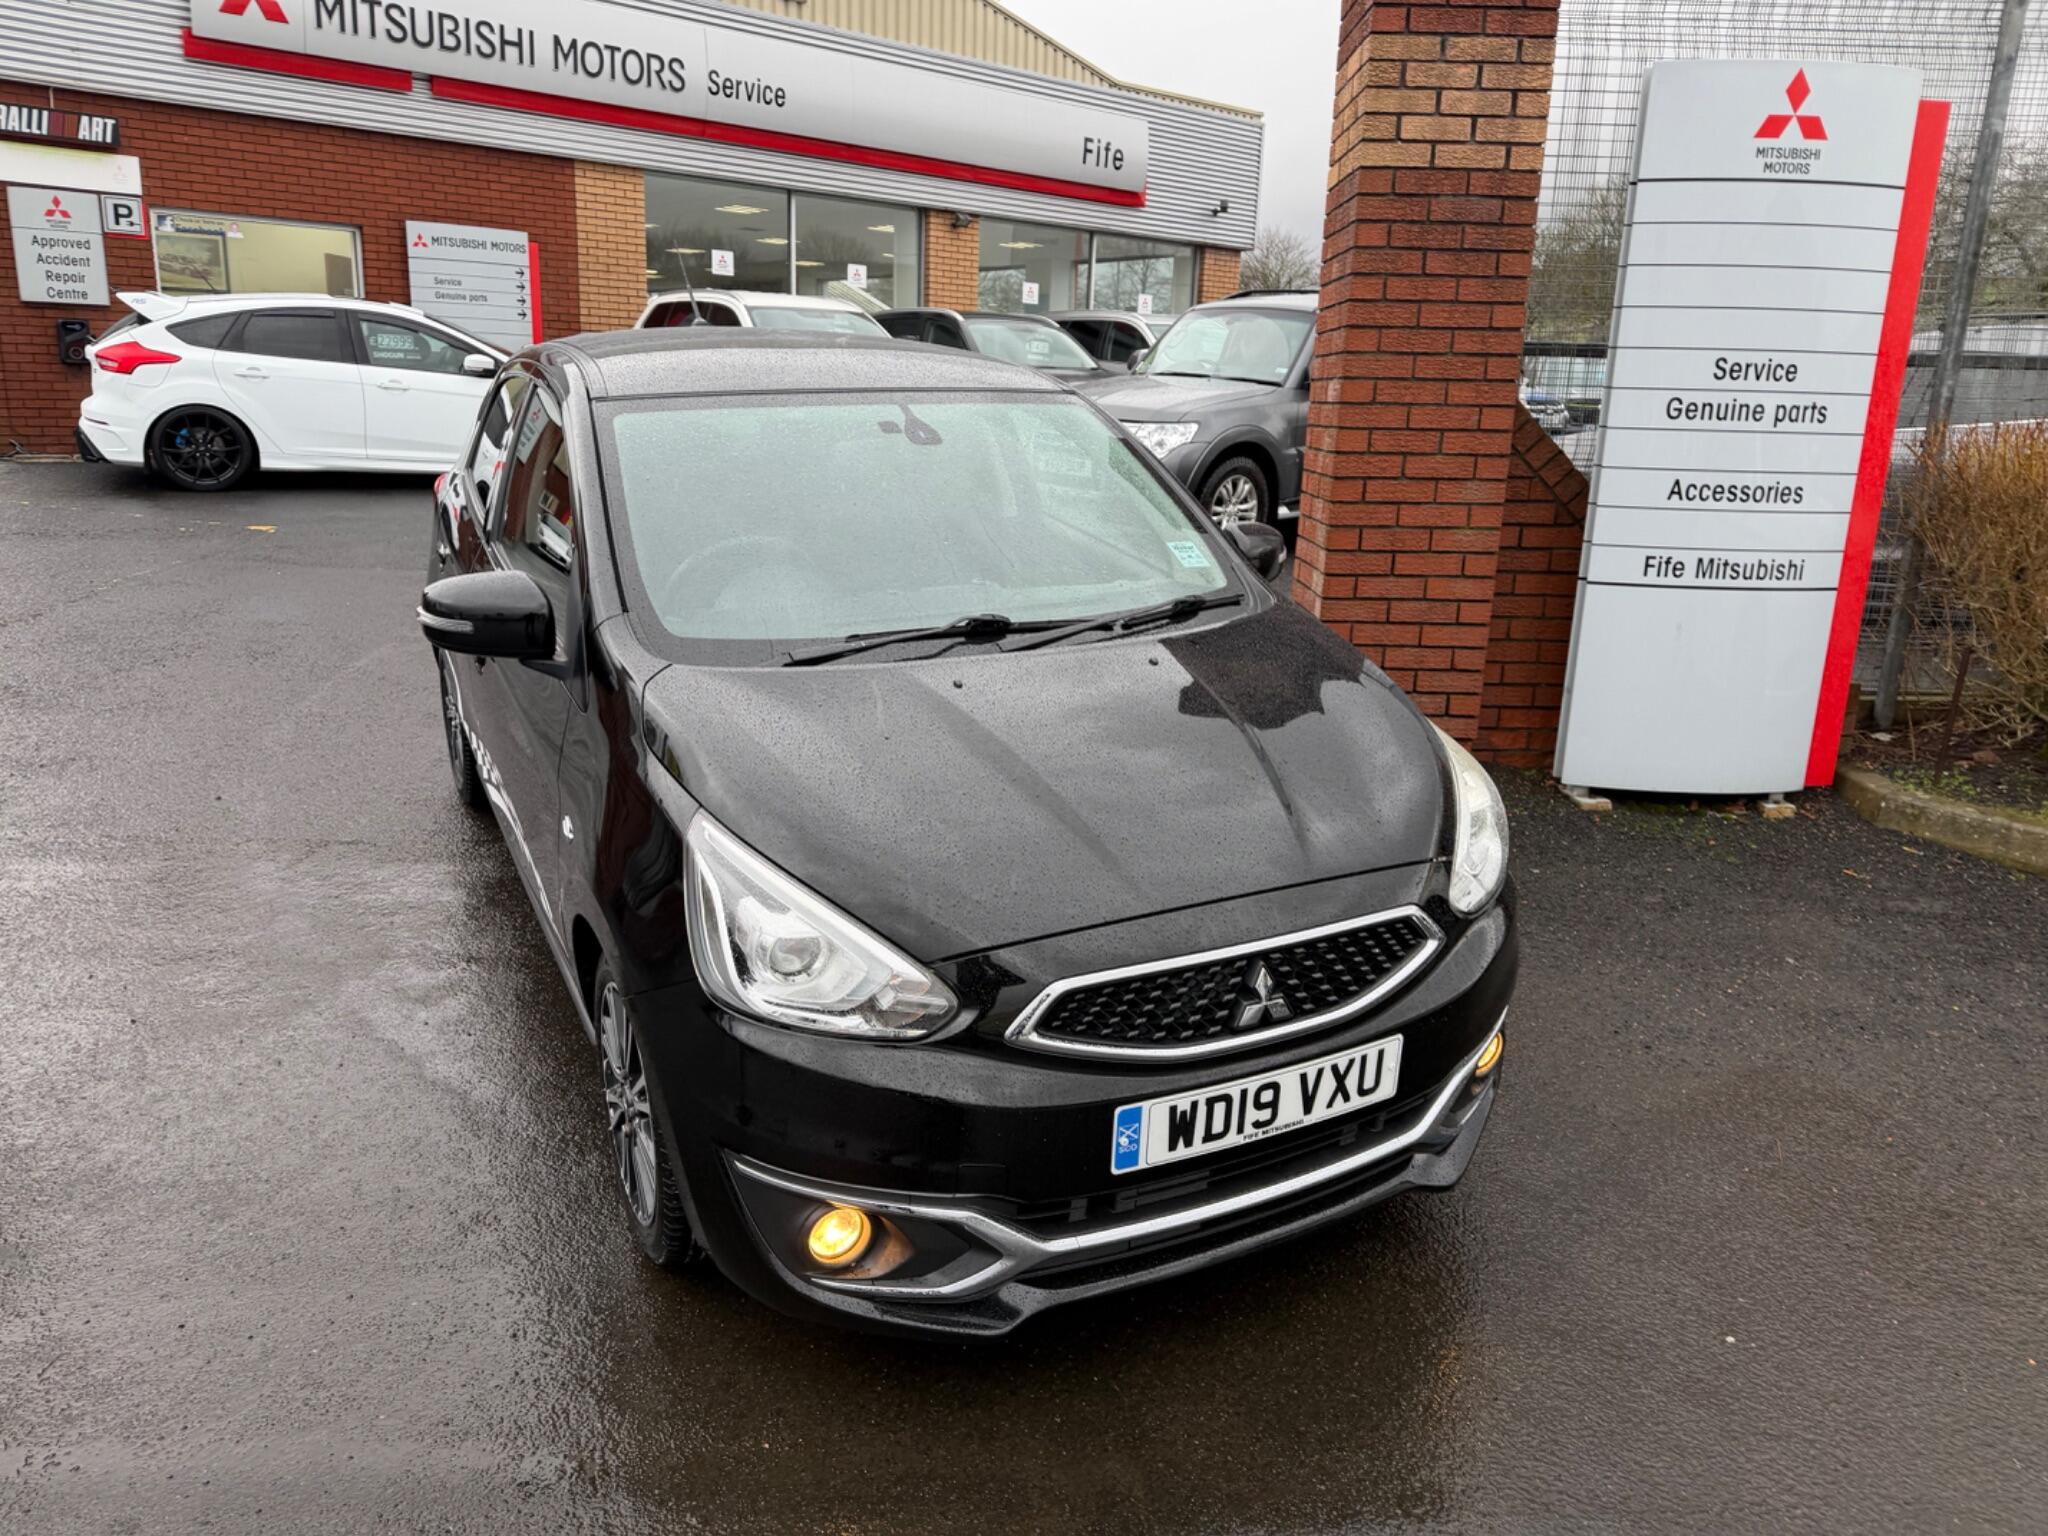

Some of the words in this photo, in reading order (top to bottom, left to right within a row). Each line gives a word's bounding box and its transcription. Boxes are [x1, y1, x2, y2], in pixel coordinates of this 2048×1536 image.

[314, 0, 536, 67] MITSUBISHI
[552, 34, 687, 93] MOTORS
[707, 69, 787, 108] Service
[78, 115, 117, 143] ART
[1082, 136, 1124, 171] Fife
[1756, 147, 1821, 160] MITSUBISHI
[1763, 162, 1811, 174] MOTORS
[113, 203, 133, 226] P
[31, 235, 91, 250] Approved
[431, 236, 487, 250] MITSUBISHI
[491, 241, 526, 254] MOTORS
[36, 253, 90, 267] Accident
[45, 270, 86, 284] Repair
[434, 276, 462, 287] Service
[46, 286, 88, 300] Centre
[435, 291, 467, 302] Genuine
[469, 293, 488, 303] parts
[1713, 357, 1798, 382] Service
[1666, 397, 1765, 422] Genuine
[1773, 401, 1828, 428] parts
[1667, 479, 1804, 504] Accessories
[1643, 555, 1685, 578] Fife
[1695, 557, 1805, 581] Mitsubishi
[1168, 1081, 1281, 1152] WD19
[1300, 1049, 1385, 1116] VXU
